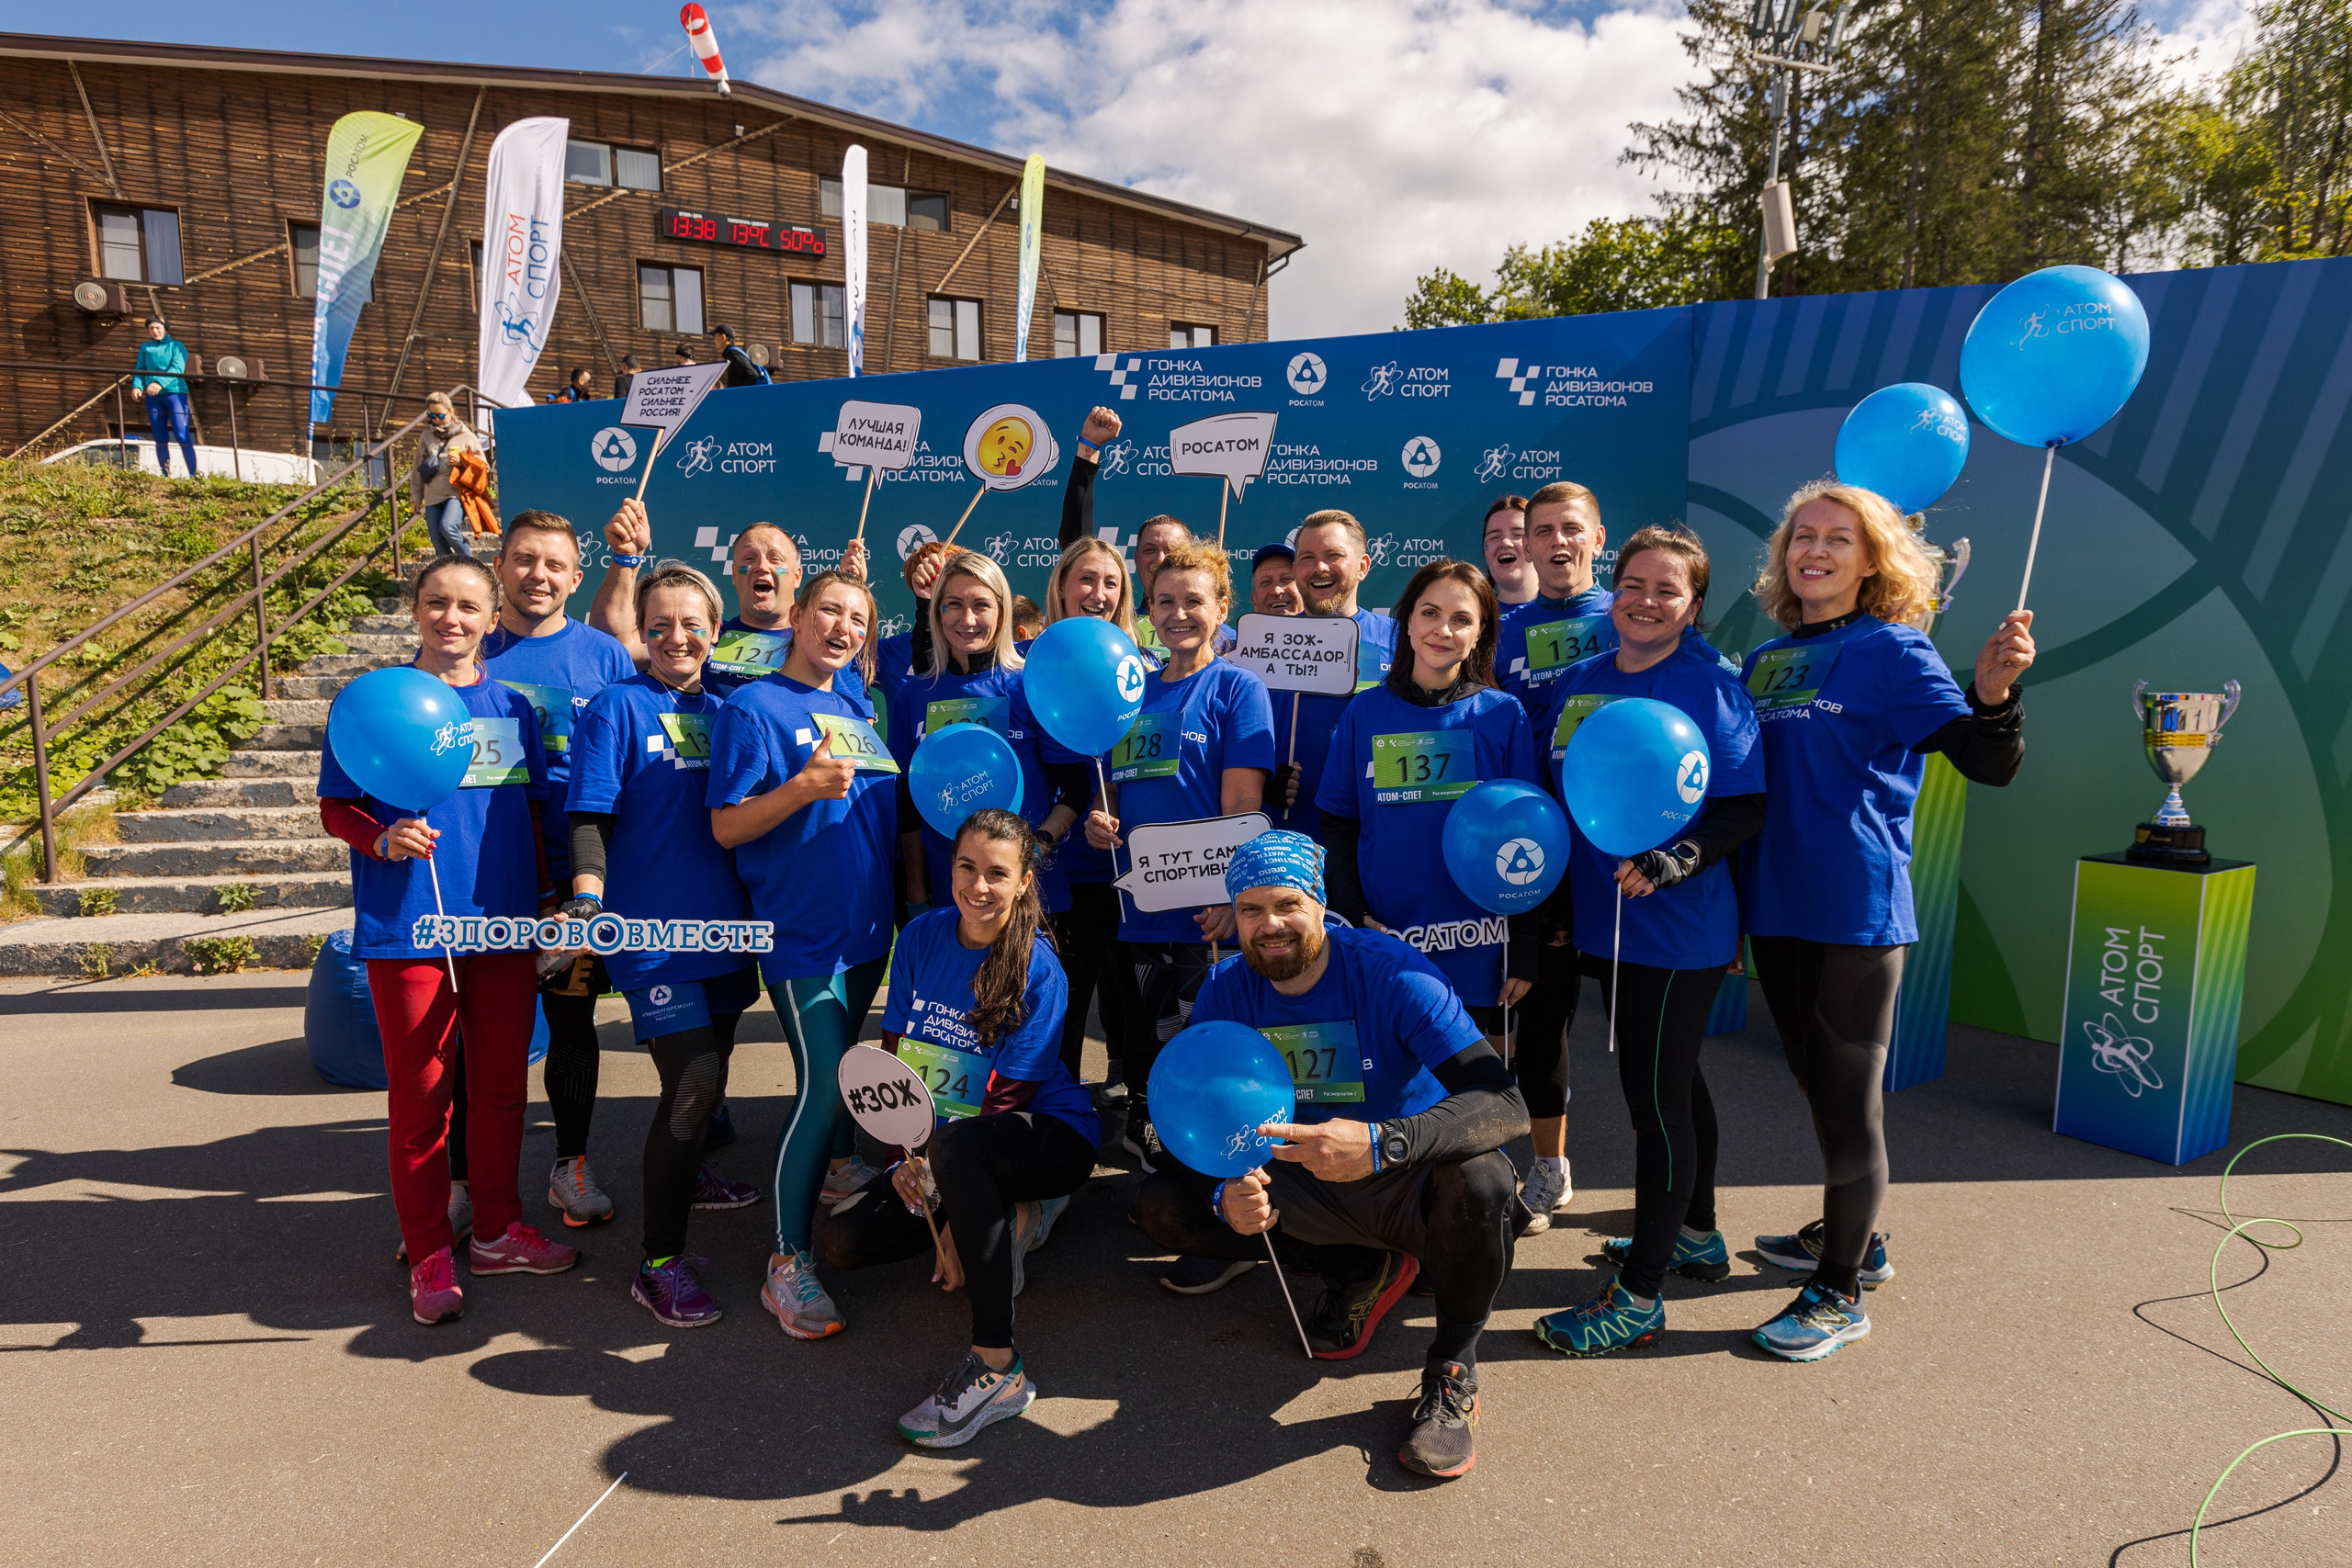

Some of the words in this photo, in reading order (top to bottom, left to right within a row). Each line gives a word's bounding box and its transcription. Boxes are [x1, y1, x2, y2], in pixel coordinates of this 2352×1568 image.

[345, 133, 368, 178] РОСАТОМ
[673, 217, 717, 240] 13:38
[507, 213, 526, 286] АТОМ
[527, 214, 548, 299] СПОРТ
[2064, 303, 2111, 316] АТОМ
[2057, 318, 2116, 334] СПОРТ
[1148, 359, 1203, 372] ГОНКА
[1407, 367, 1449, 380] АТОМ
[1546, 367, 1598, 378] ГОНКА
[647, 376, 692, 385] СИЛЬНЕЕ
[1148, 374, 1262, 388] ДИВИЗИОНОВ
[1545, 380, 1653, 393] ДИВИЗИОНОВ
[639, 387, 684, 396] РОСАТОМ
[1148, 389, 1235, 401] РОСАТОМА
[1401, 384, 1451, 397] СПОРТ
[640, 398, 685, 406] СИЛЬНЕЕ
[1545, 395, 1627, 407] РОСАТОМА
[639, 408, 681, 417] РОССИЯ!
[848, 418, 904, 435] ЛУЧШАЯ
[1943, 415, 1967, 435] АТОМ
[839, 433, 907, 452] КОМАНДА!
[1937, 424, 1967, 446] СПОРТ
[727, 443, 773, 456] АТОМ
[1182, 438, 1259, 455] РОСАТОМ
[1519, 450, 1560, 463] АТОМ
[721, 460, 776, 473] СПОРТ
[1267, 459, 1377, 471] ДИВИЗИОНОВ
[1512, 467, 1562, 479] СПОРТ
[1267, 473, 1351, 485] РОСАТОМА
[1403, 539, 1443, 551] АТОМ
[1396, 555, 1446, 567] СПОРТ
[1264, 633, 1274, 644] Я
[1283, 634, 1323, 646] ЗОЖ-
[734, 646, 775, 664] 121
[1240, 647, 1347, 663] АМБАССАДОР.
[1549, 635, 1600, 662] 134
[1266, 663, 1275, 673] А
[1285, 664, 1317, 676] ТЫ?!
[1763, 664, 1810, 694] 123
[839, 732, 877, 754] 126
[1125, 733, 1161, 762] 128
[470, 739, 502, 764] 25
[1396, 753, 1450, 783] 137
[961, 771, 989, 791] АТОМ
[961, 779, 994, 802] СПОРТ
[1138, 856, 1149, 868] Я
[1159, 851, 1193, 865] ТУТ
[1258, 866, 1287, 876] arena
[1499, 889, 1541, 898] РОСАТОМ
[2099, 927, 2131, 1007] АТОМ
[2132, 925, 2165, 1023] СПОРТ
[928, 1002, 966, 1021] ГОНКА
[1286, 1048, 1336, 1080] 127
[918, 1065, 969, 1099] 124
[848, 1077, 922, 1114] #ЗОЖ
